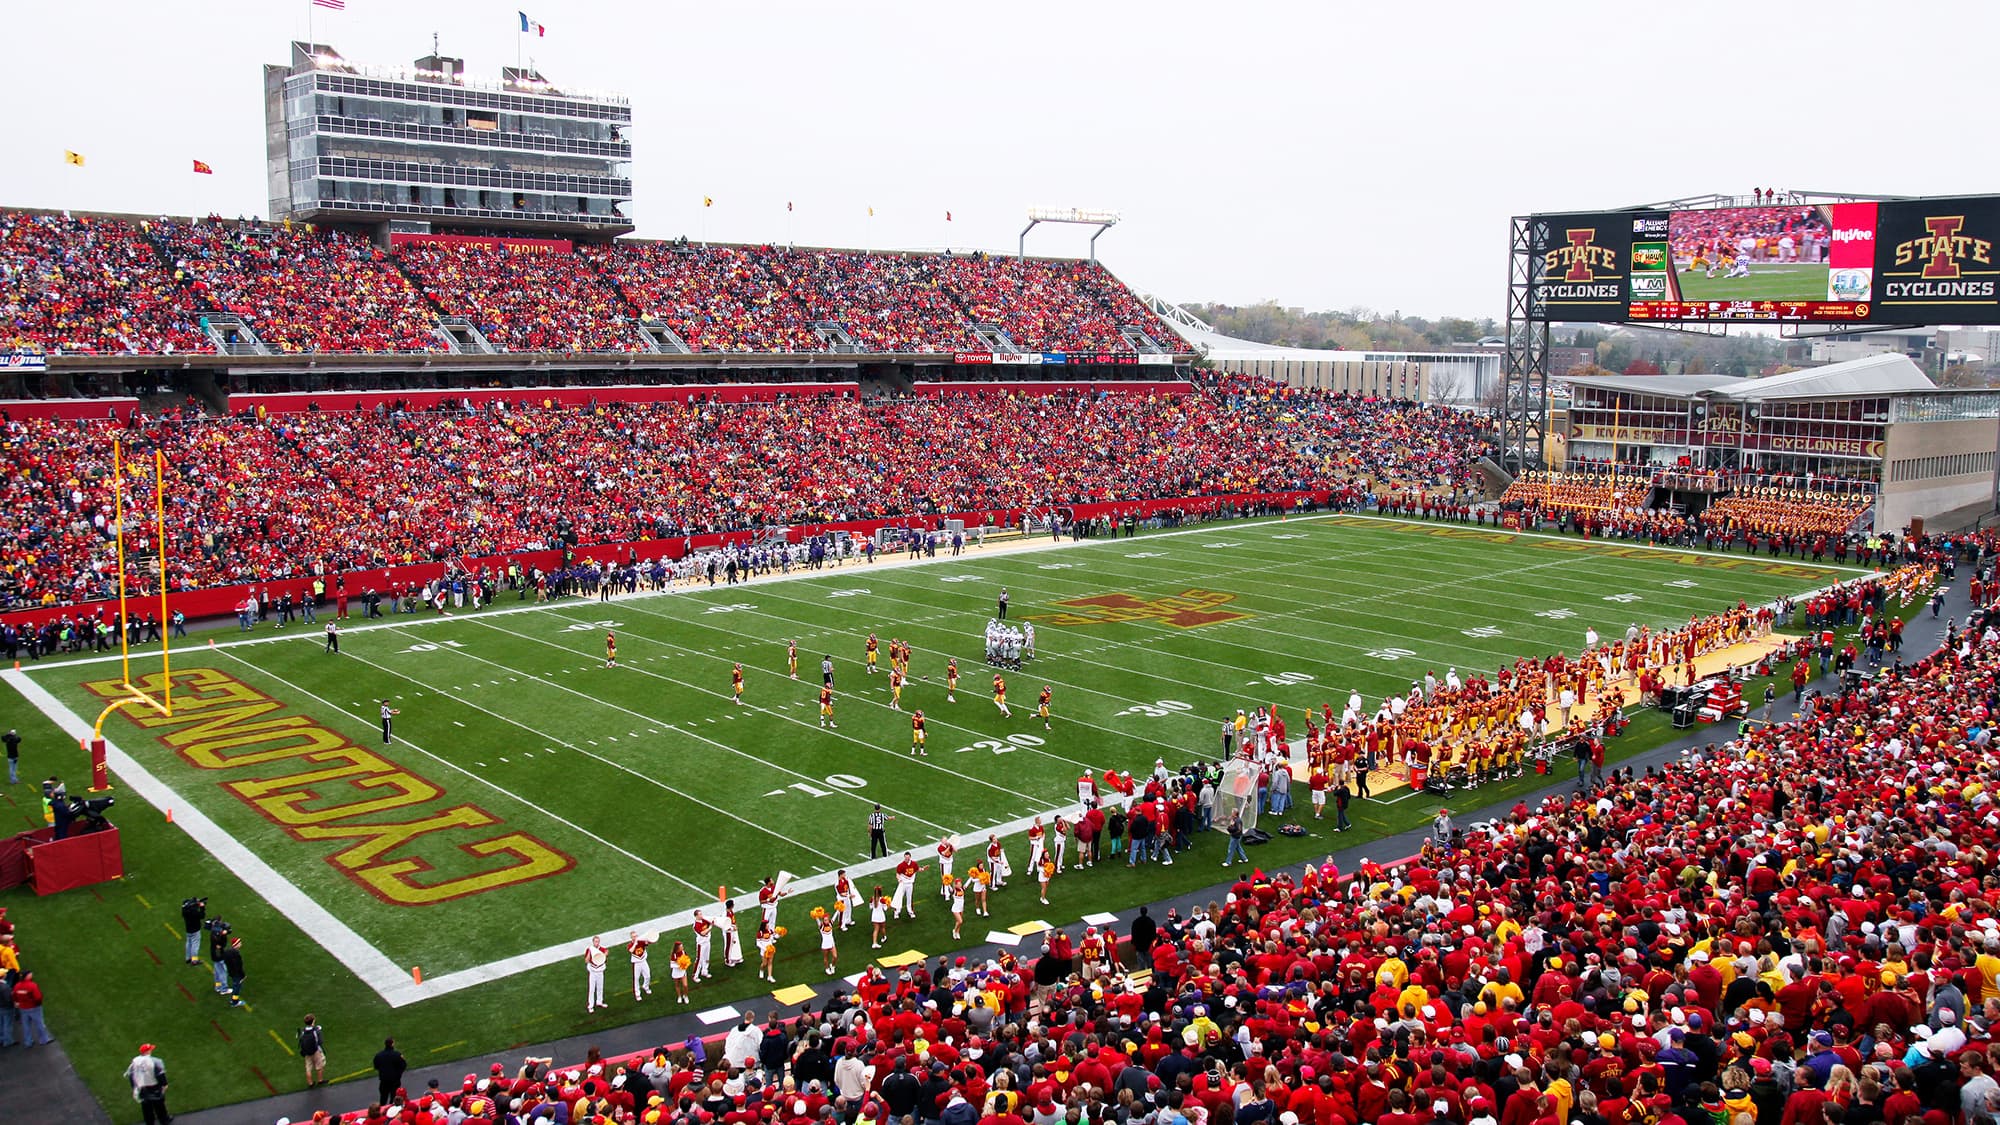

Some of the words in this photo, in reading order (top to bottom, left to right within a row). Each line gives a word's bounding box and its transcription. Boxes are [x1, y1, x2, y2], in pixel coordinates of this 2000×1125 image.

[452, 241, 492, 252] RICE
[1895, 235, 1992, 266] STATE
[1545, 246, 1616, 271] STATE
[1538, 285, 1619, 298] CYCLONES
[1886, 282, 1995, 296] CYCLONES
[1691, 307, 1697, 316] 3
[1790, 307, 1797, 315] 7
[1596, 427, 1628, 439] IOWA
[1772, 438, 1861, 453] CYCLONES
[1525, 540, 1840, 582] STATE
[1364, 647, 1417, 660] 50
[1263, 671, 1315, 686] 40
[1127, 699, 1194, 717] 30
[972, 733, 1046, 755] 20
[79, 667, 578, 907] CYCLONES
[788, 773, 868, 798] 10
[1085, 947, 1099, 959] 84
